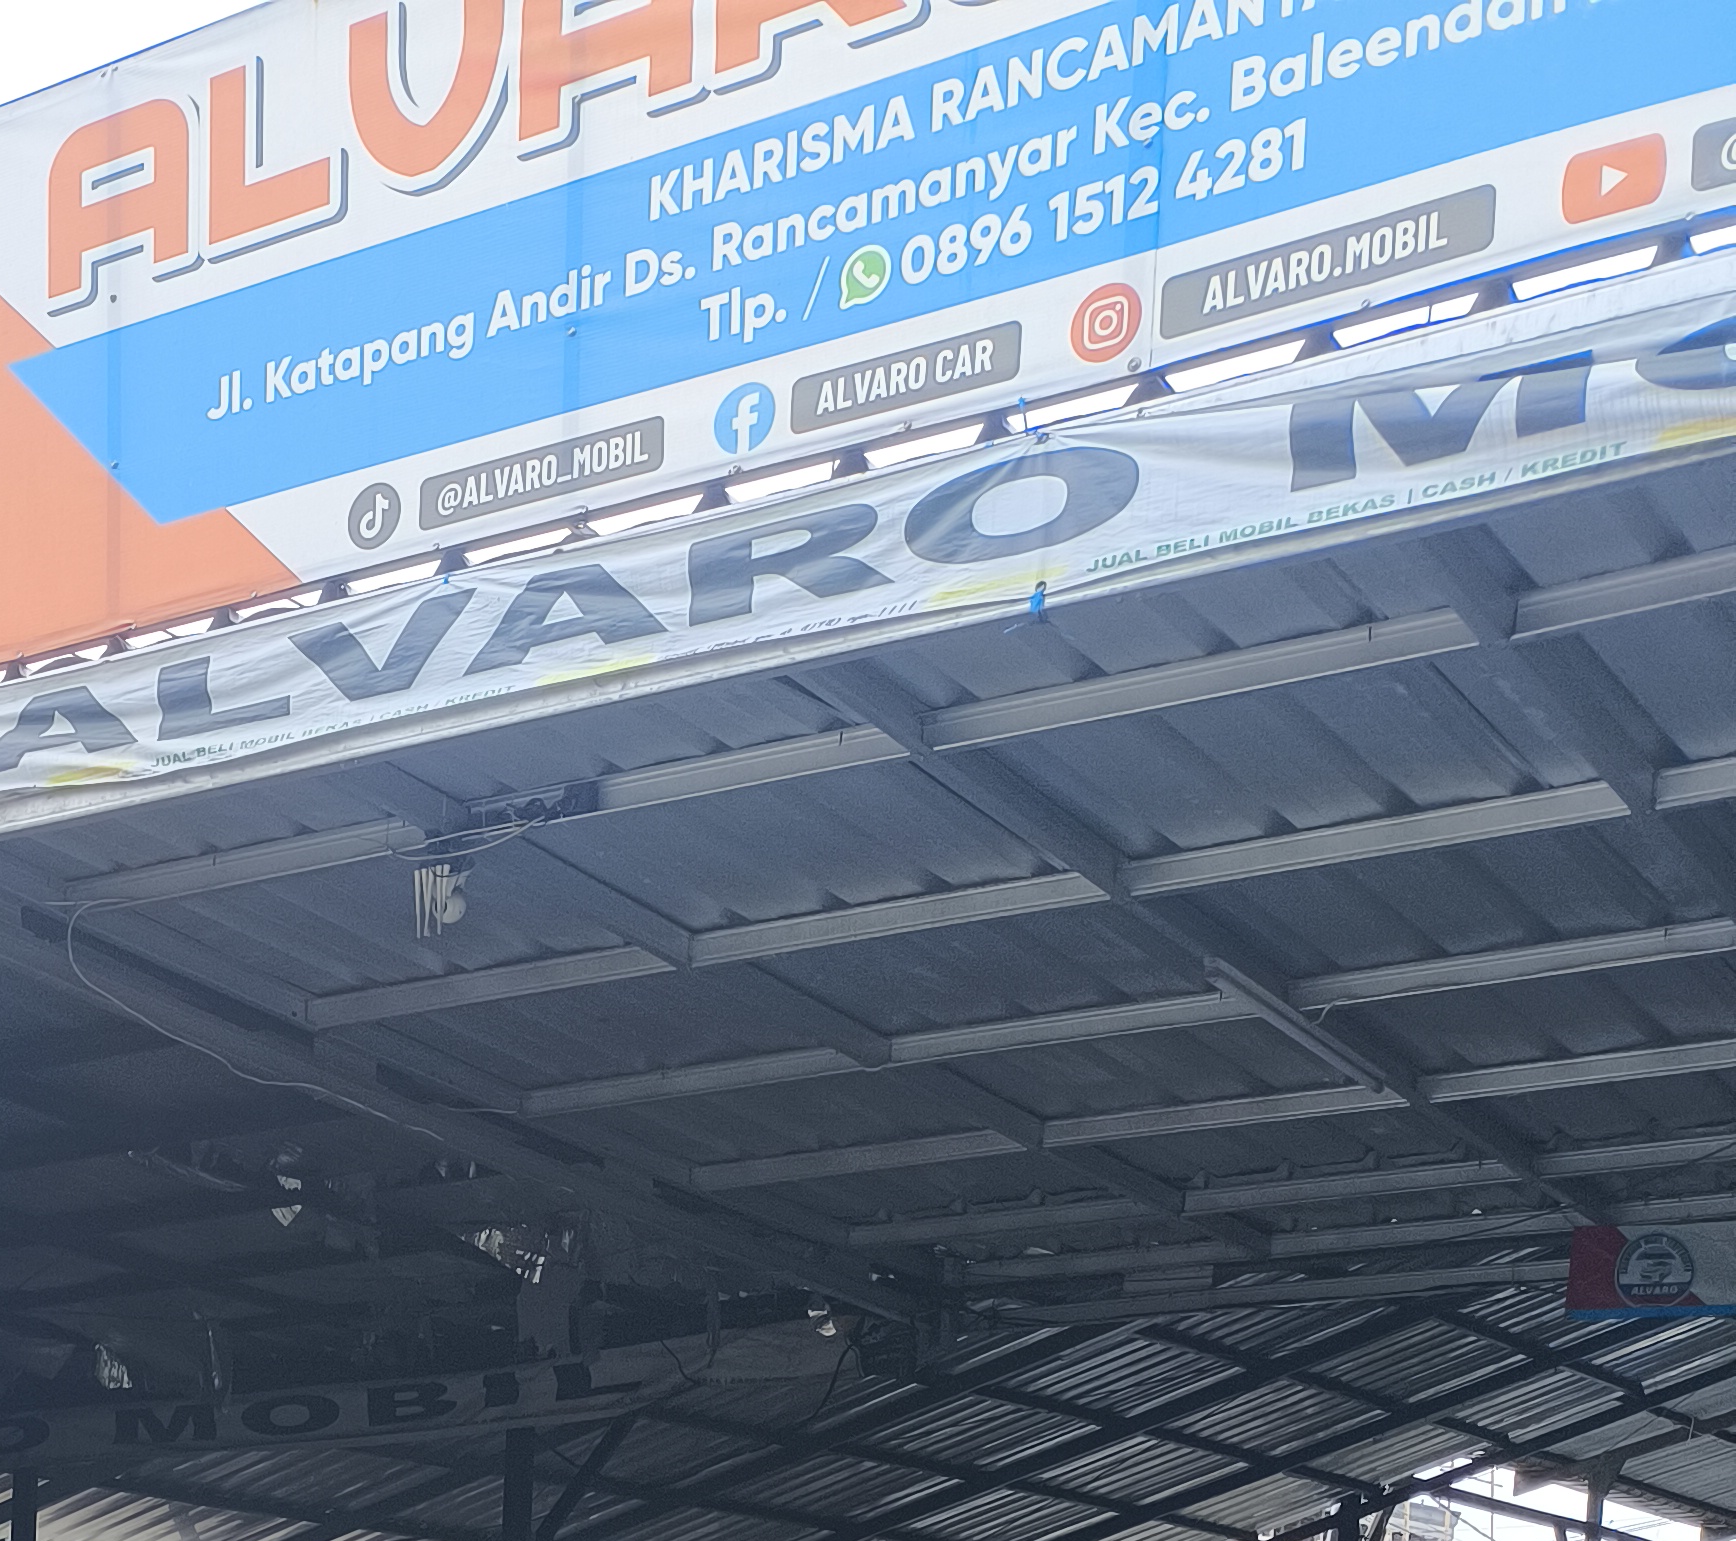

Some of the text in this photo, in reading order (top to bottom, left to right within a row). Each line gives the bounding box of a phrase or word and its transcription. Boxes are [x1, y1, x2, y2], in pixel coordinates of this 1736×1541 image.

[47, 0, 934, 316] ALVA
[648, 96, 915, 221] KHARISMA
[207, 370, 253, 421] Jl.
[265, 311, 475, 404] Katapang
[486, 263, 611, 338] Andir
[624, 246, 696, 298] Ds.
[711, 124, 1078, 272] Rancamanyar
[1093, 87, 1210, 155] Kec.
[699, 283, 787, 344] Tlp.
[900, 204, 1032, 286] 0896
[1049, 166, 1159, 242] 1512
[1175, 117, 1307, 202] 4281
[1201, 225, 1449, 316] ALVARO.MOBIL
[816, 337, 994, 417] ALVARO CAR
[436, 430, 650, 517] @ALVARO_MOBIL
[1085, 548, 1148, 574] JUAL
[1155, 534, 1210, 558] BELI
[1217, 515, 1299, 545] MOBIL
[1306, 493, 1397, 525] BEKAS
[1420, 471, 1497, 500] CASH
[1519, 440, 1631, 477] KREDIT
[149, 750, 192, 768] JUAL
[194, 741, 234, 758] BELI
[1630, 1283, 1680, 1297] ALVARO
[114, 1360, 645, 1447] MOBIL
